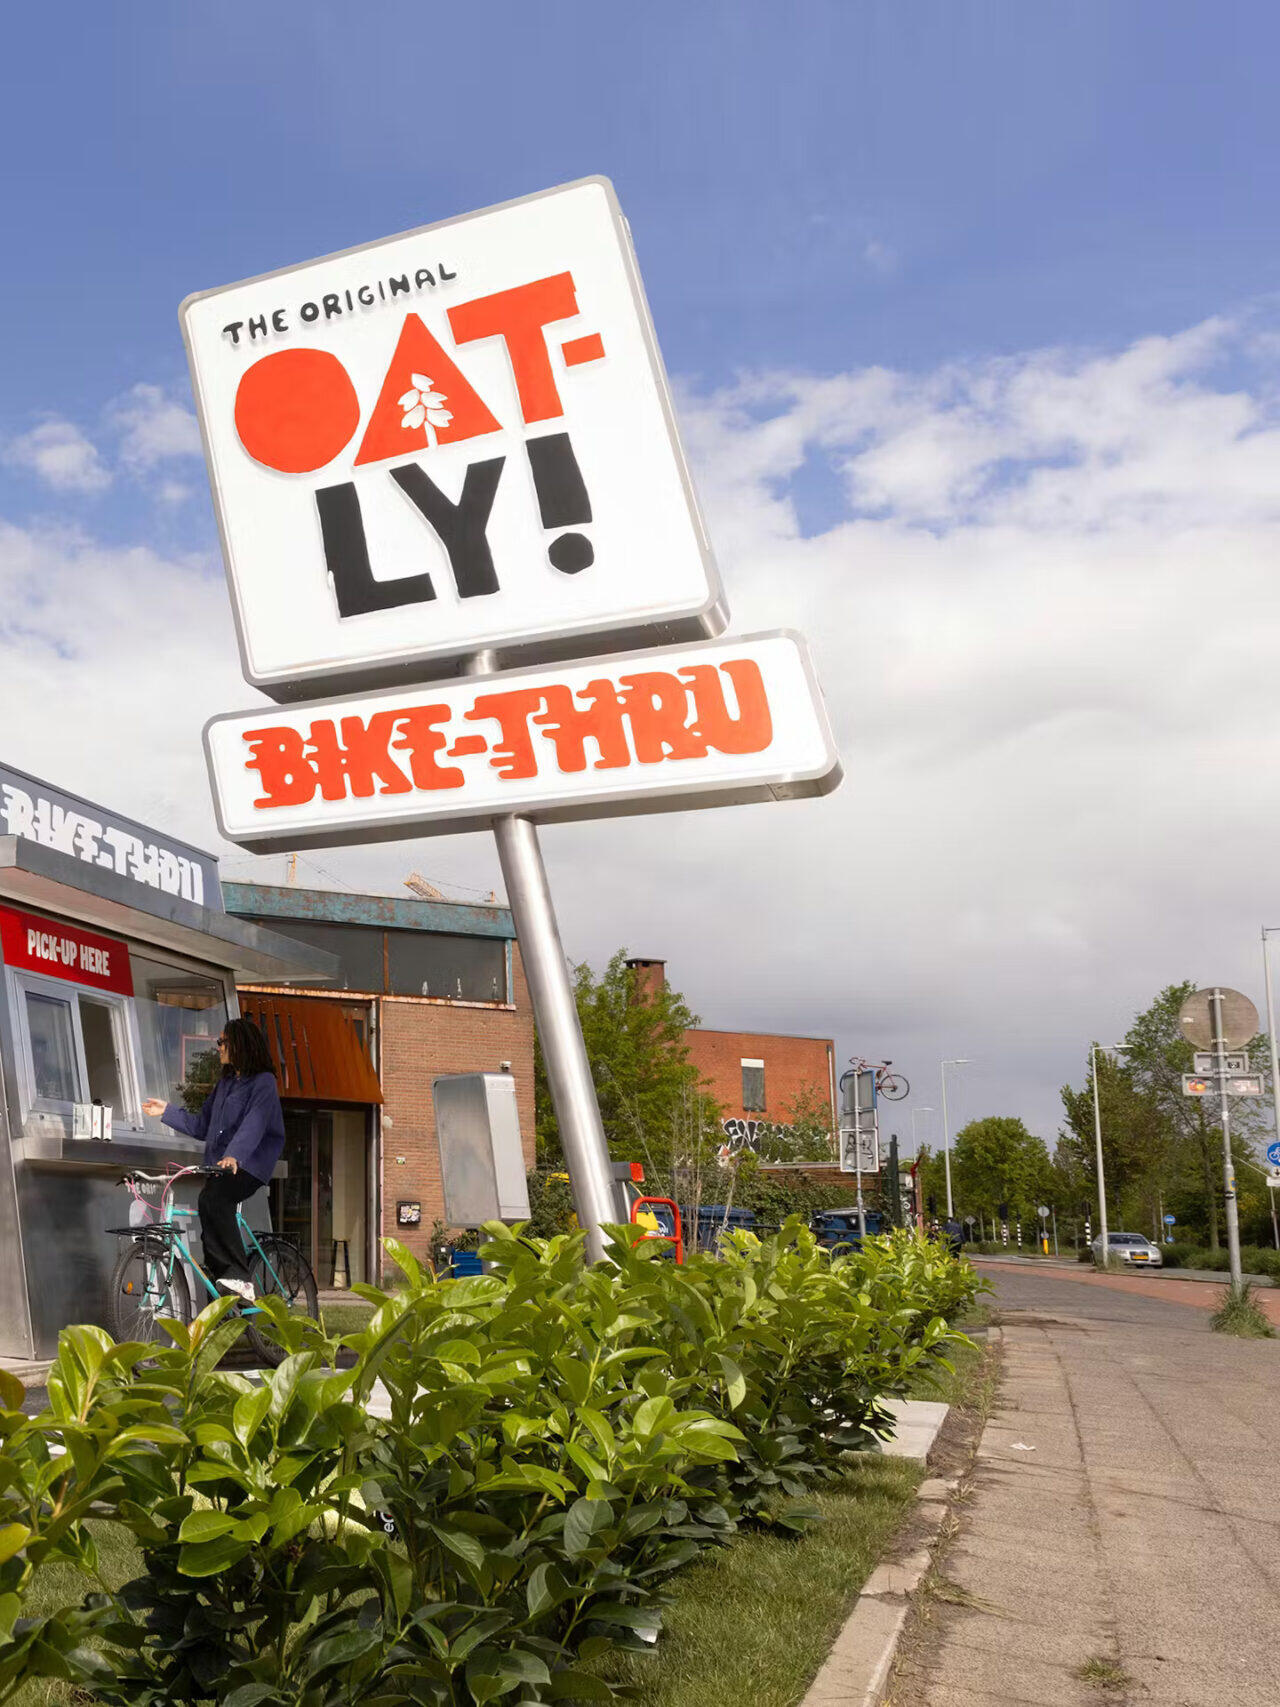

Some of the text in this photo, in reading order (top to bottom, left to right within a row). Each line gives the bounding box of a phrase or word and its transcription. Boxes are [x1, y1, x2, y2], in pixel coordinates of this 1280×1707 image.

[223, 263, 457, 344] THE ORIGINAL
[314, 432, 594, 618] LY!
[241, 658, 776, 809] BIKE-THRU
[27, 928, 111, 977] PICK-UP HERE
